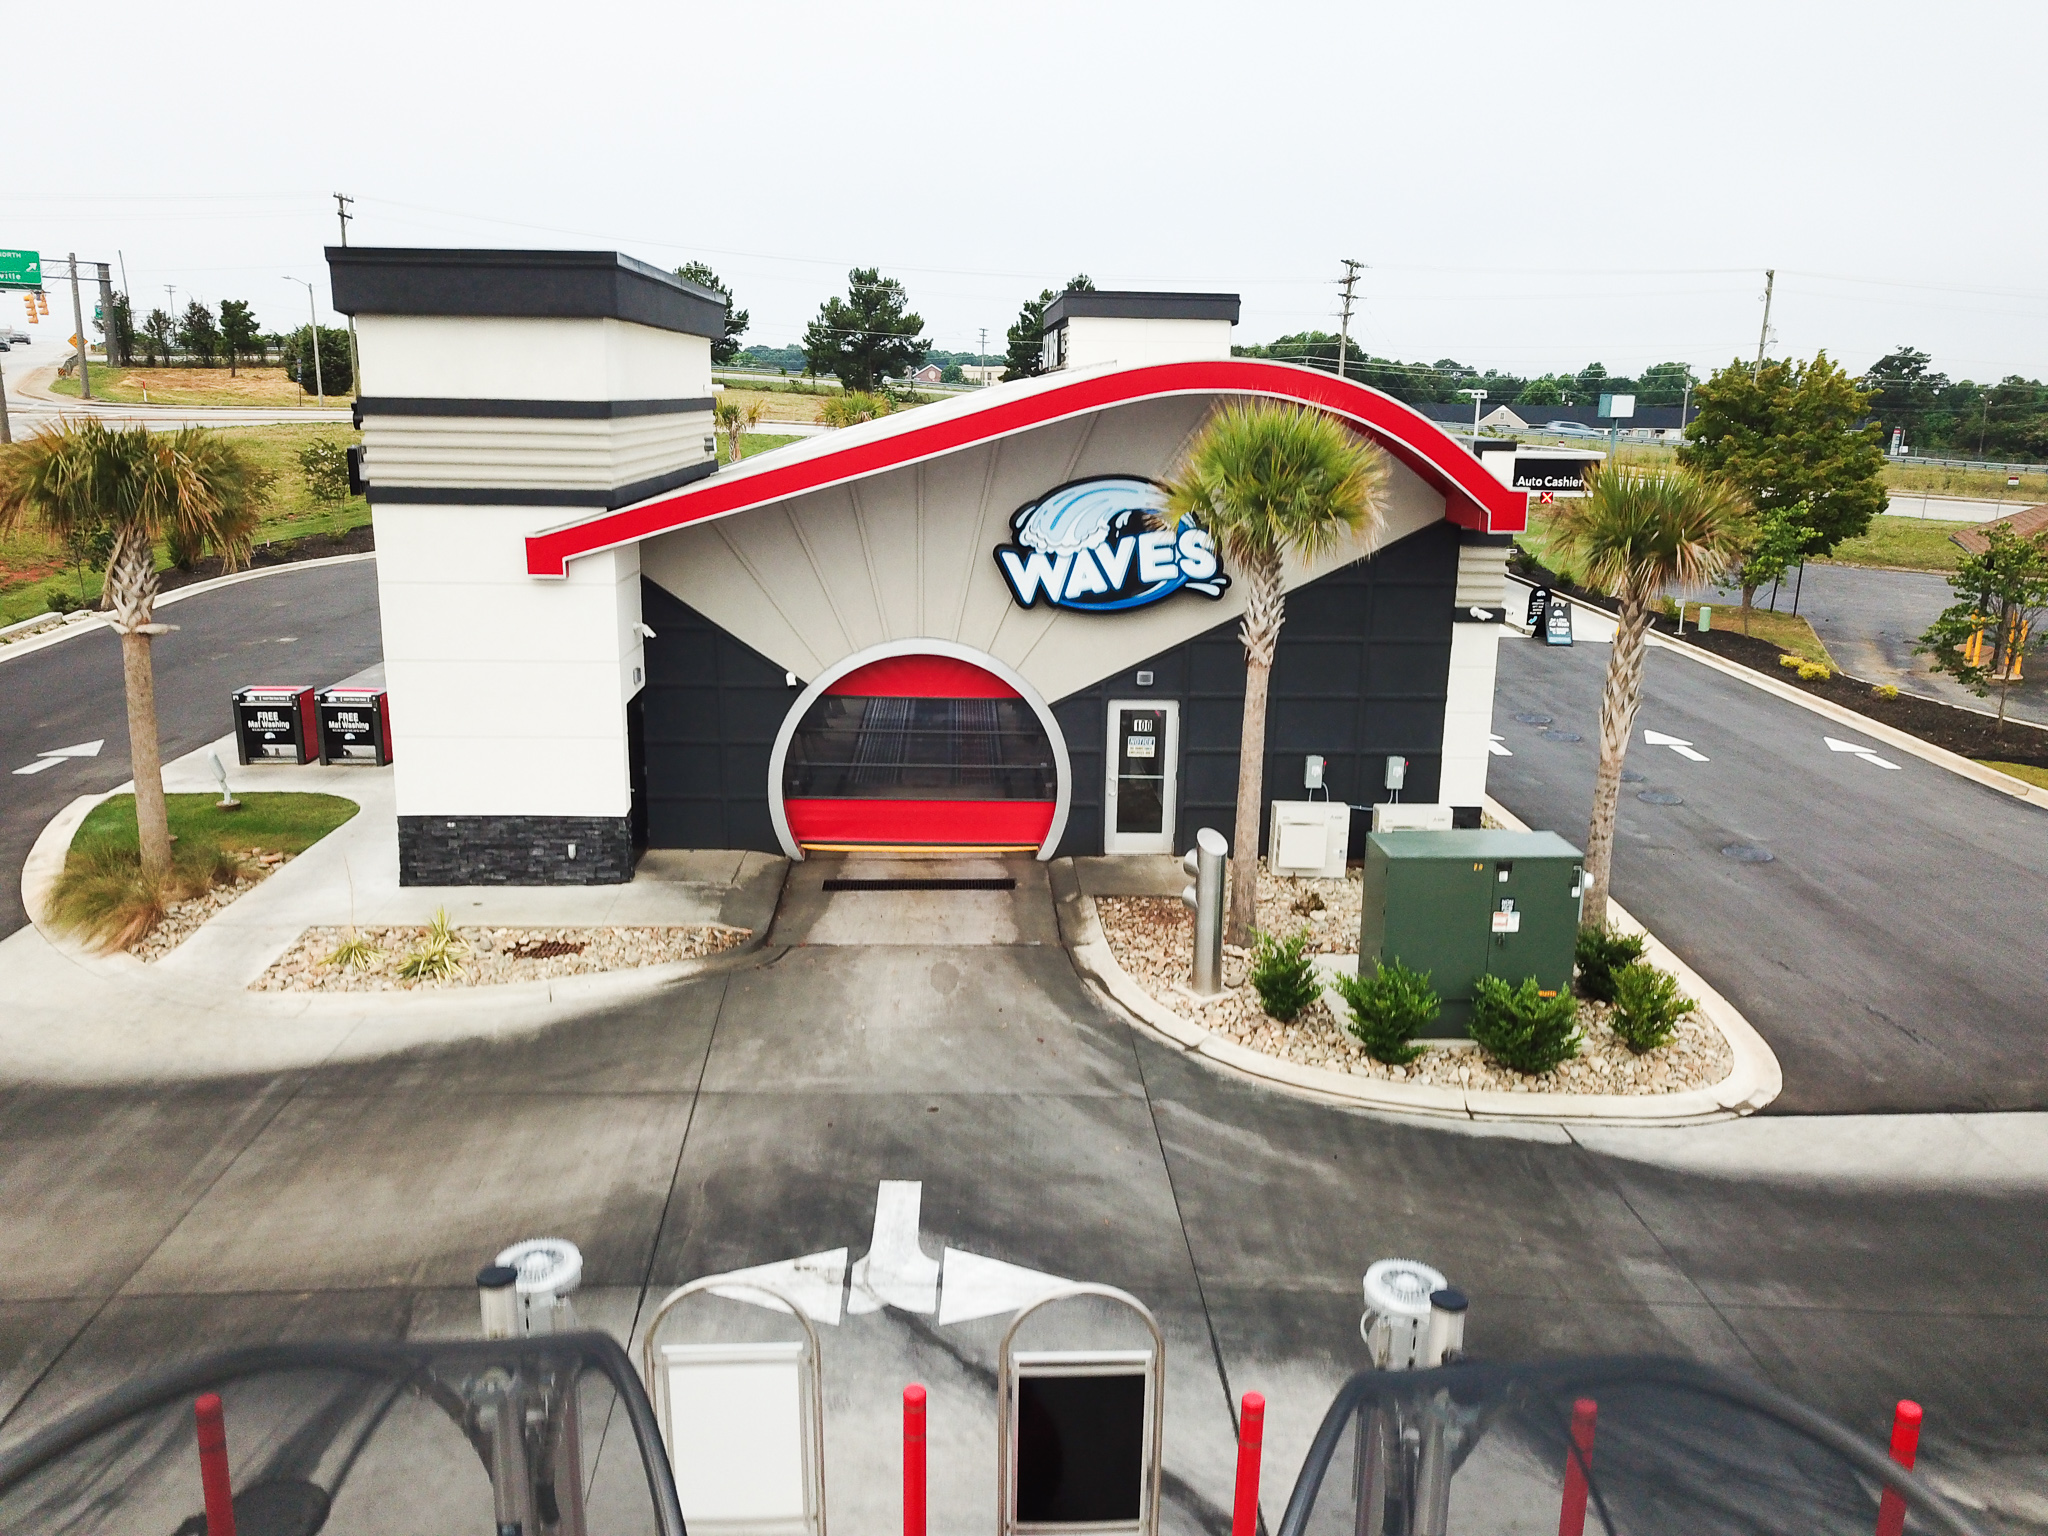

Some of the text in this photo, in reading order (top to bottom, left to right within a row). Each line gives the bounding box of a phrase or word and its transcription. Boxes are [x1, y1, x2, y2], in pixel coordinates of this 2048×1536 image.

[1517, 476, 1583, 487] Auto Cashier
[1001, 529, 1217, 604] WAVES
[257, 711, 279, 721] FREE
[337, 712, 359, 722] FREE
[247, 720, 290, 729] Mat Washing
[328, 721, 369, 730] Mat Washing
